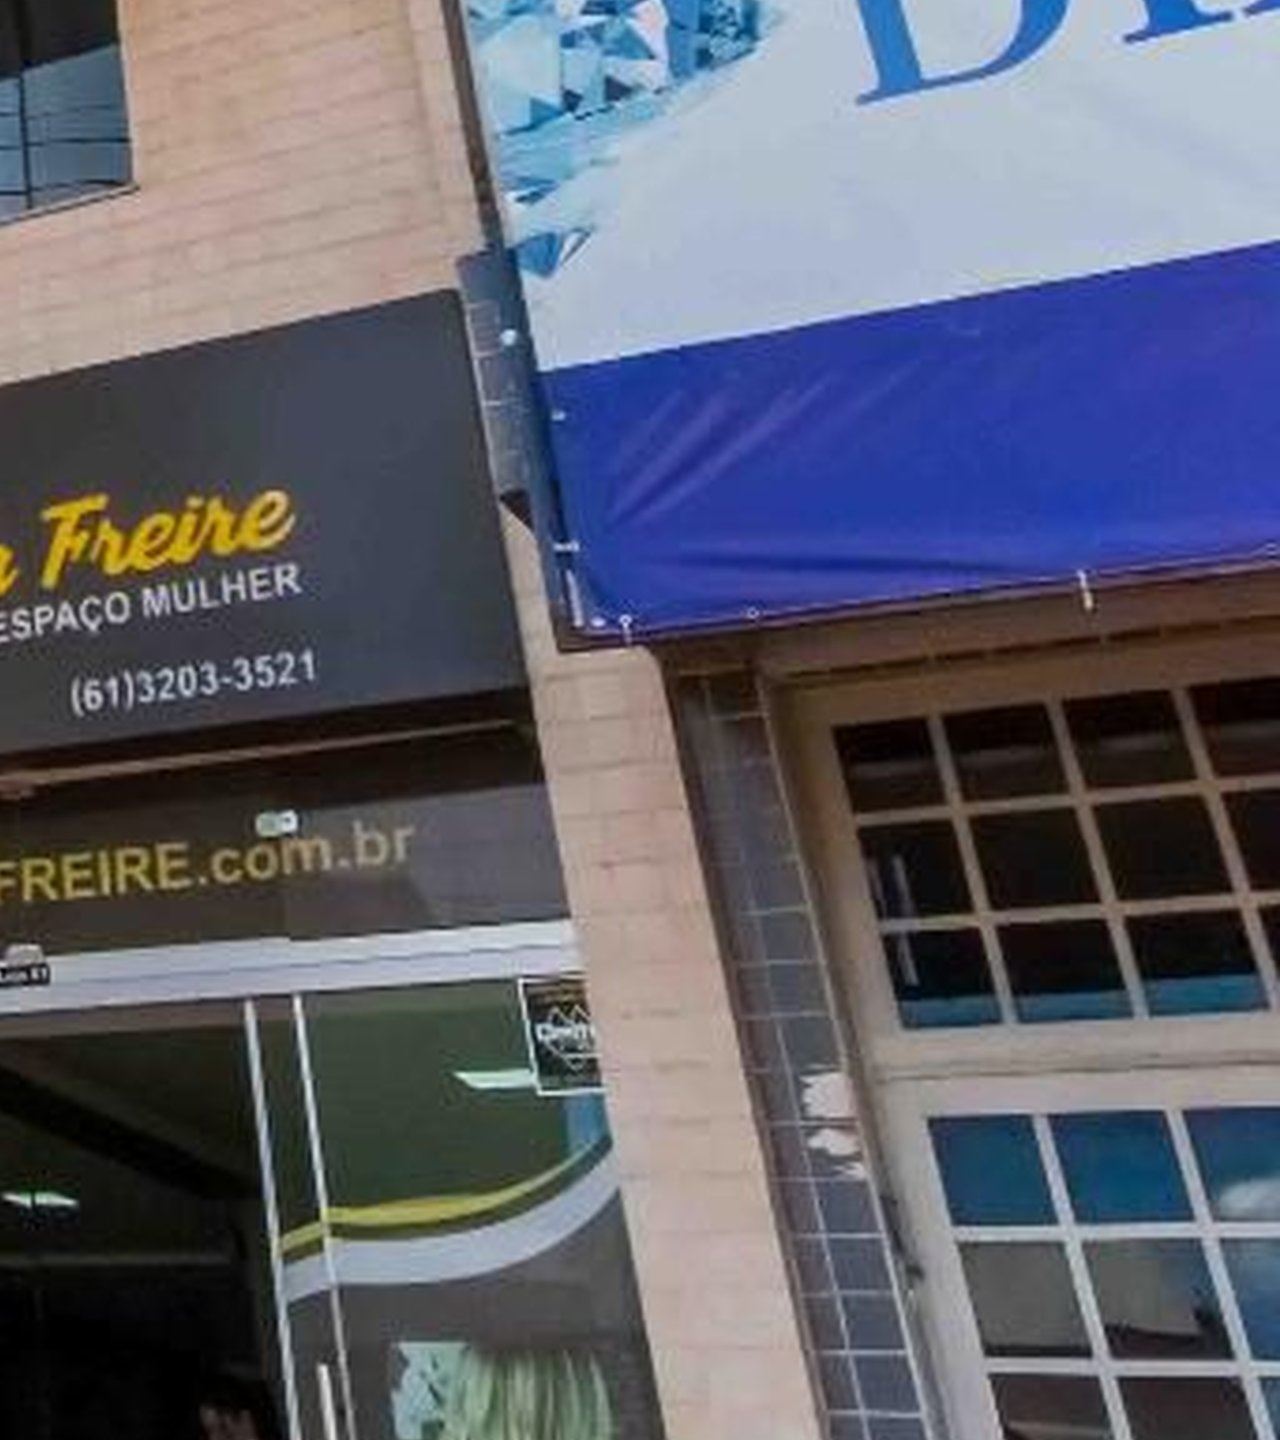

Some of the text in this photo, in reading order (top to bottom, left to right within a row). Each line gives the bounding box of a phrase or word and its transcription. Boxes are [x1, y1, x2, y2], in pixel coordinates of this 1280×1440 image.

[41, 490, 297, 590] Freire
[141, 561, 304, 620] MULHER
[70, 648, 318, 717] (61)3203-3521
